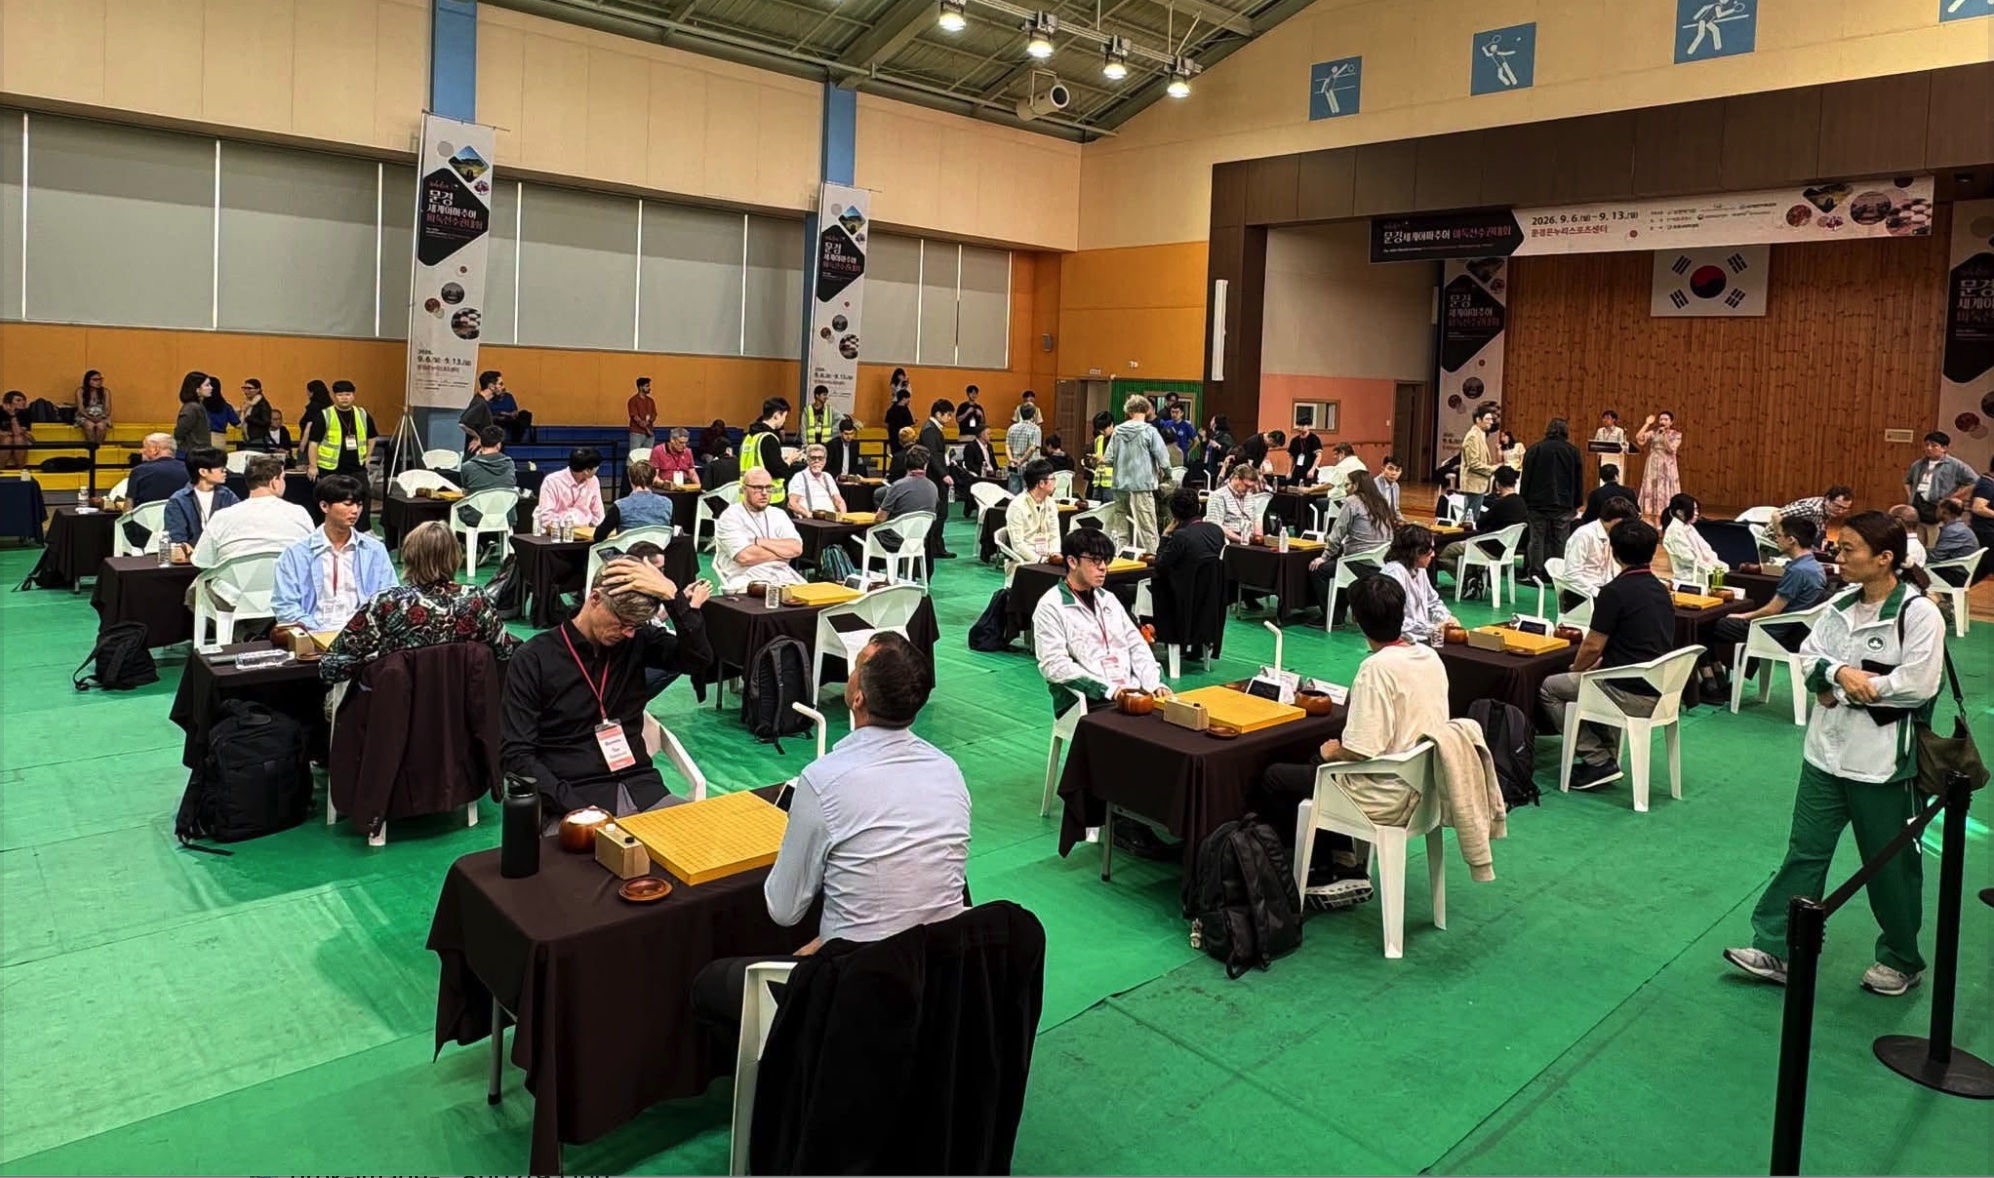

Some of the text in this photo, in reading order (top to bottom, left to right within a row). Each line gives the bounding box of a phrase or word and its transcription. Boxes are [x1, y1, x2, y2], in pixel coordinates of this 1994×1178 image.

[428, 190, 453, 206] 문경
[1531, 216, 1558, 226] 2026.
[824, 241, 842, 255] 문경
[1960, 279, 1994, 297] 문경
[1449, 294, 1471, 308] 문경
